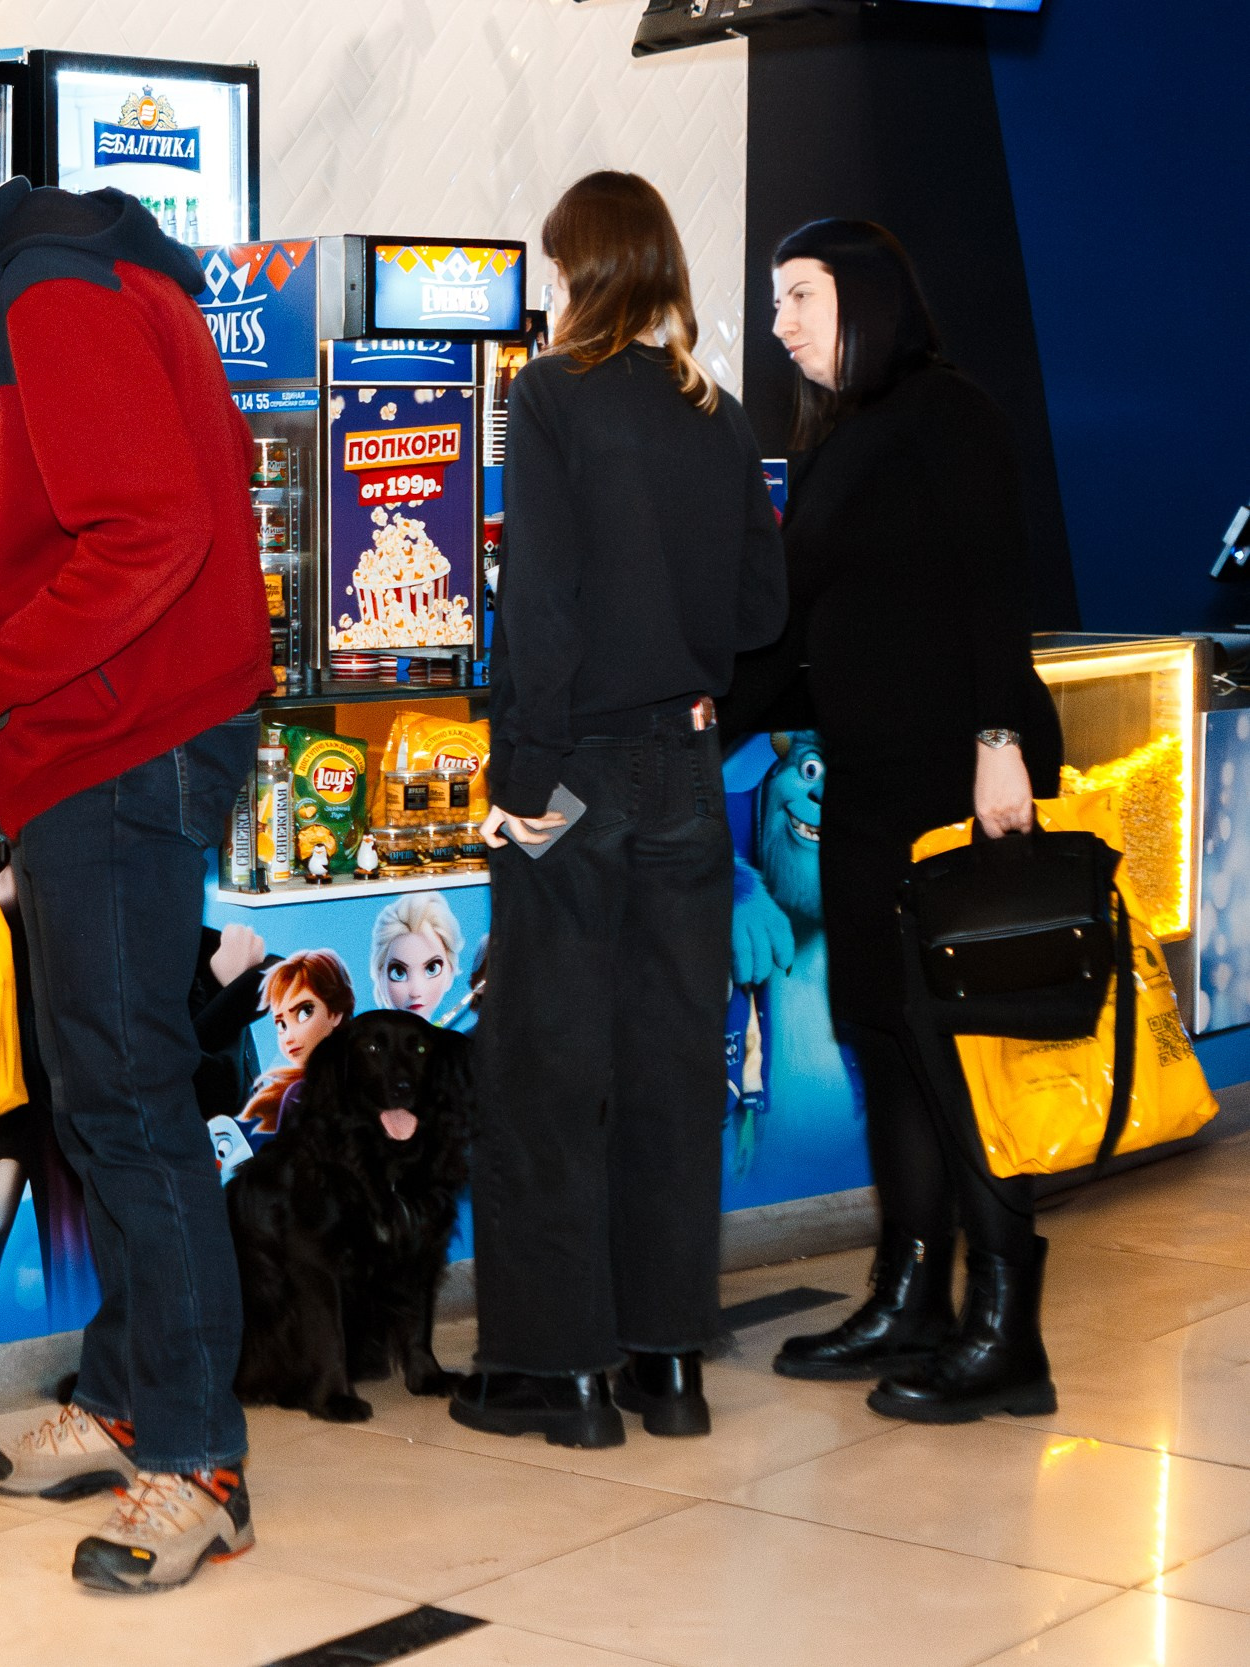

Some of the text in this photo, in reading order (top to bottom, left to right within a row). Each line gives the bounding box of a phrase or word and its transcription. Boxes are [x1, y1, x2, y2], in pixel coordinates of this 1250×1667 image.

[112, 133, 195, 158] БАЛТИКА
[203, 307, 266, 355] RVESS
[241, 393, 254, 410] 14
[255, 392, 271, 409] 55
[347, 430, 457, 465] ПОПКОРН
[361, 482, 383, 499] от
[317, 768, 355, 793] Lay's
[276, 788, 287, 863] СЕНЕЖСКАЯ
